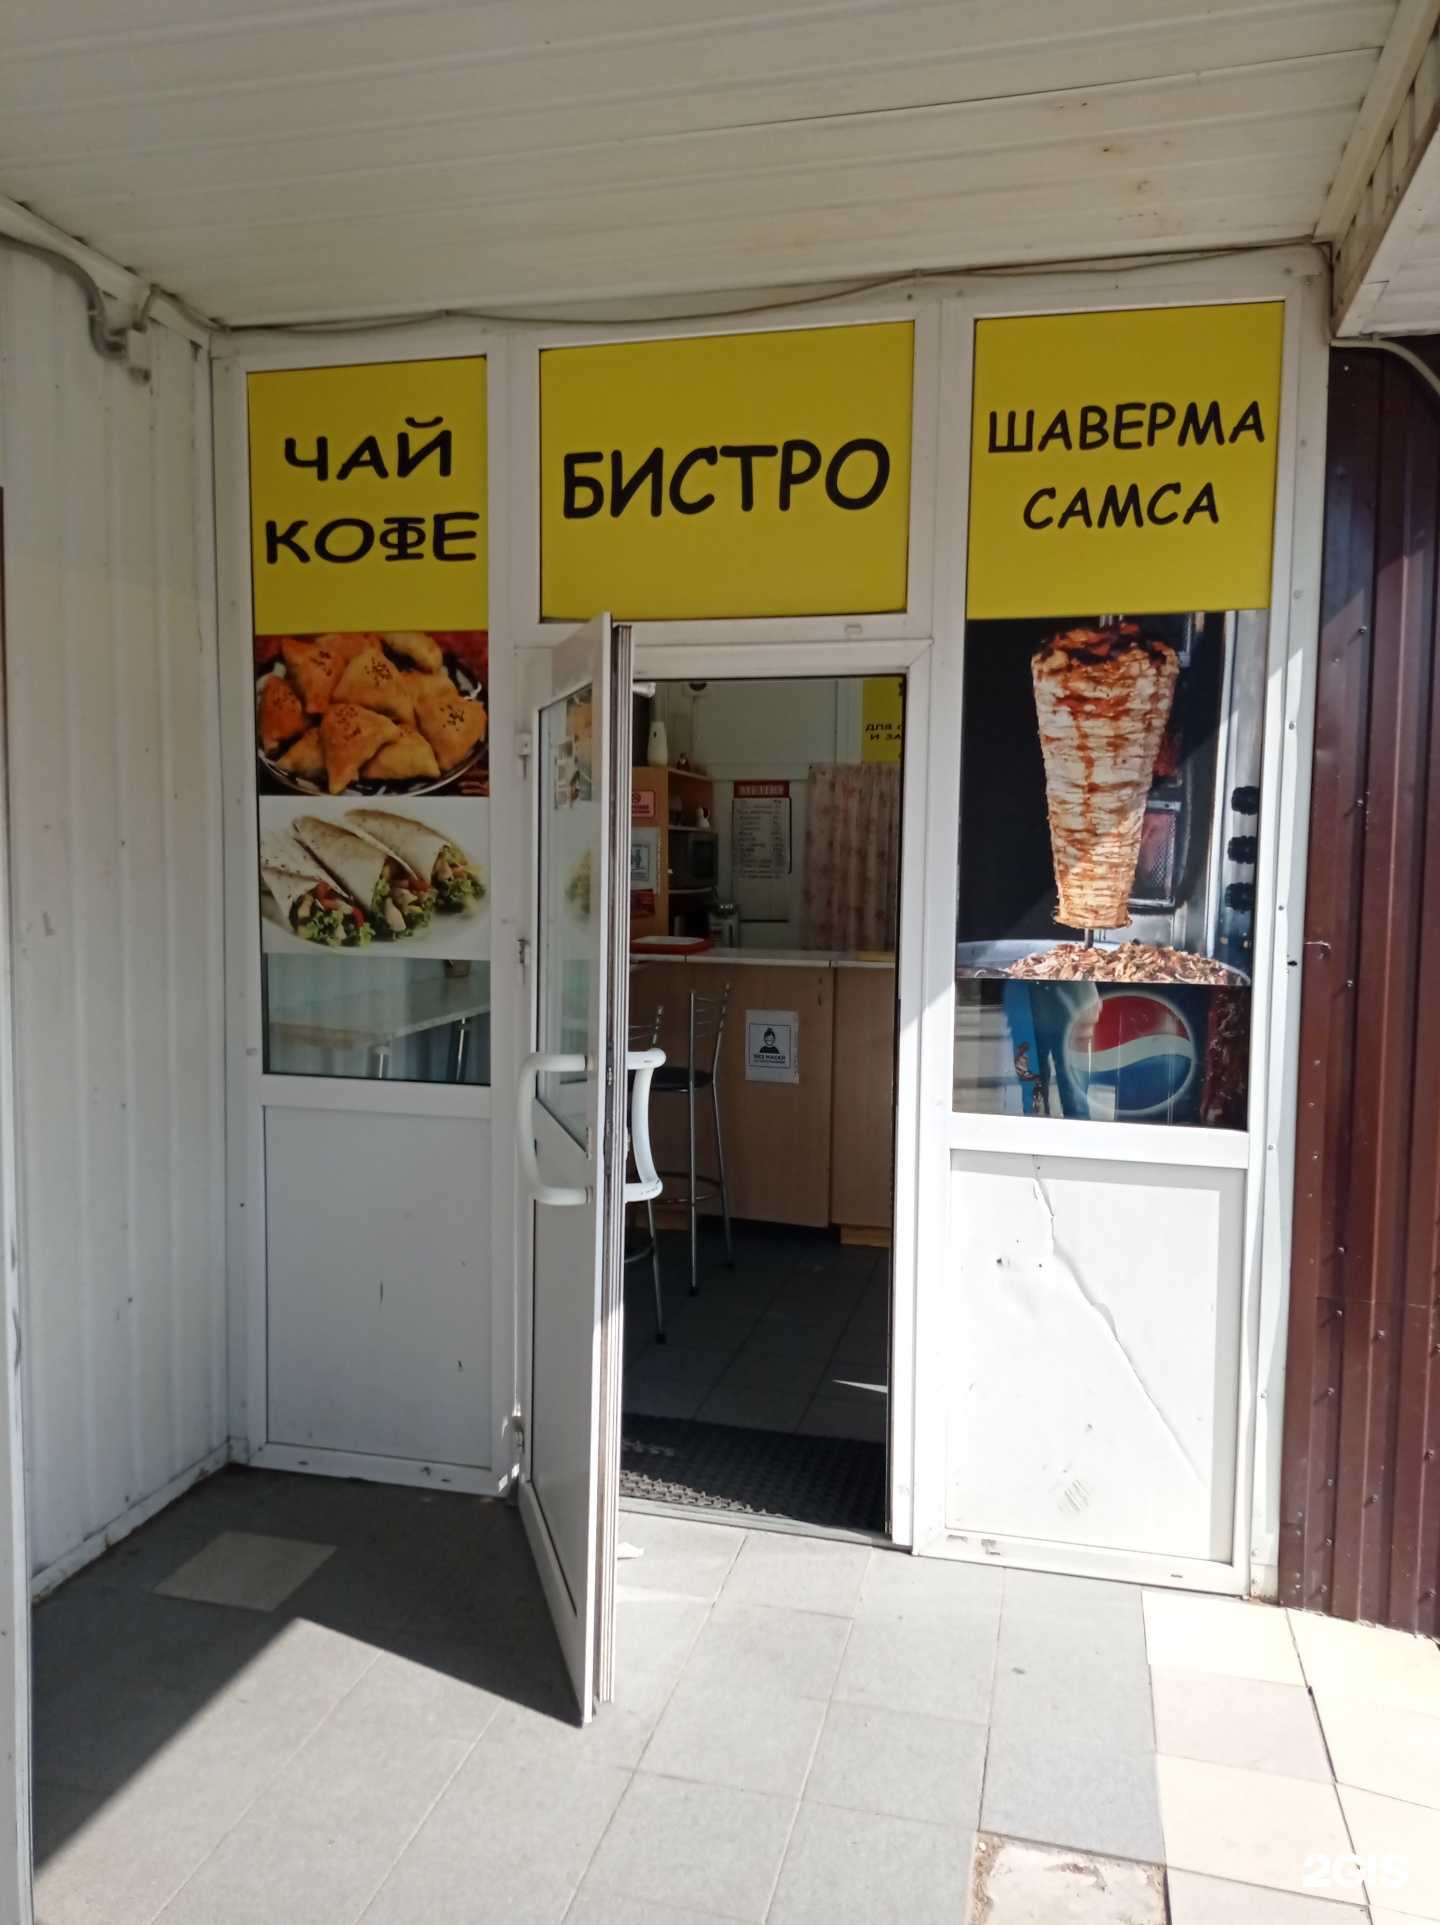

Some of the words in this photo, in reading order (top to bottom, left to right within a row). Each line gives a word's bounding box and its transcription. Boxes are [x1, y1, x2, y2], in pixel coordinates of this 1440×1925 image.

[283, 415, 453, 482] ЧАЙ
[988, 400, 1265, 454] ШАВЕРМА
[562, 437, 892, 520] БИСТРО
[1022, 481, 1220, 530] САМСА
[264, 511, 480, 565] КОФЕ
